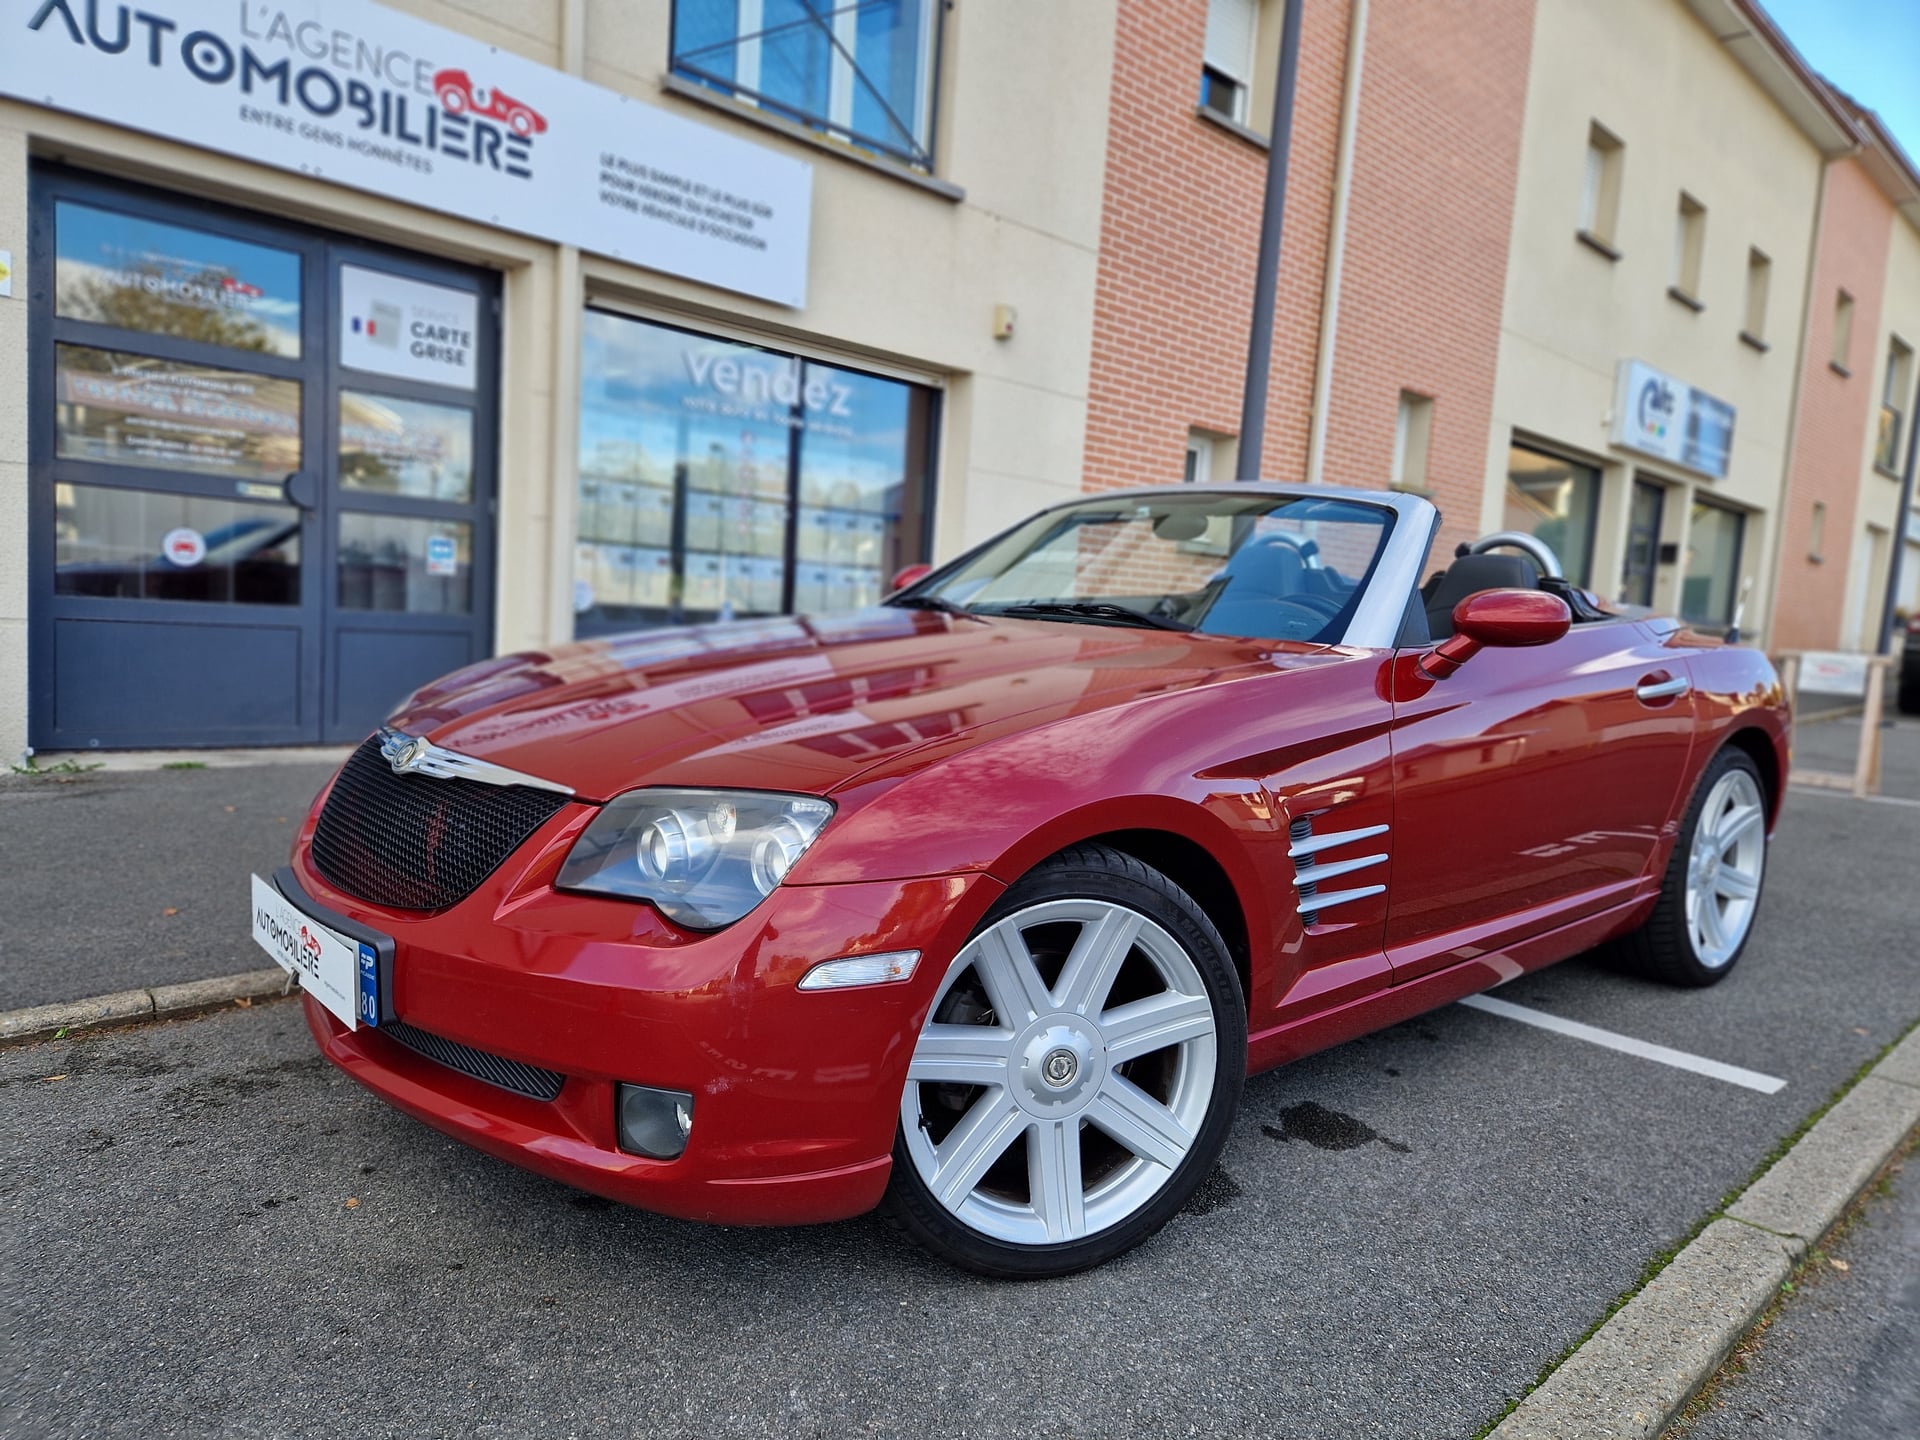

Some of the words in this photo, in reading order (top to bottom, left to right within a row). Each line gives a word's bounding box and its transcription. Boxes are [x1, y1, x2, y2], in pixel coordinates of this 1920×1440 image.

[239, 0, 434, 96] L'AGENCE
[239, 104, 294, 136] ENTRE
[298, 121, 345, 149] GENS
[410, 320, 472, 349] CARTE
[410, 340, 467, 368] GRISE
[361, 991, 375, 1019] 80
